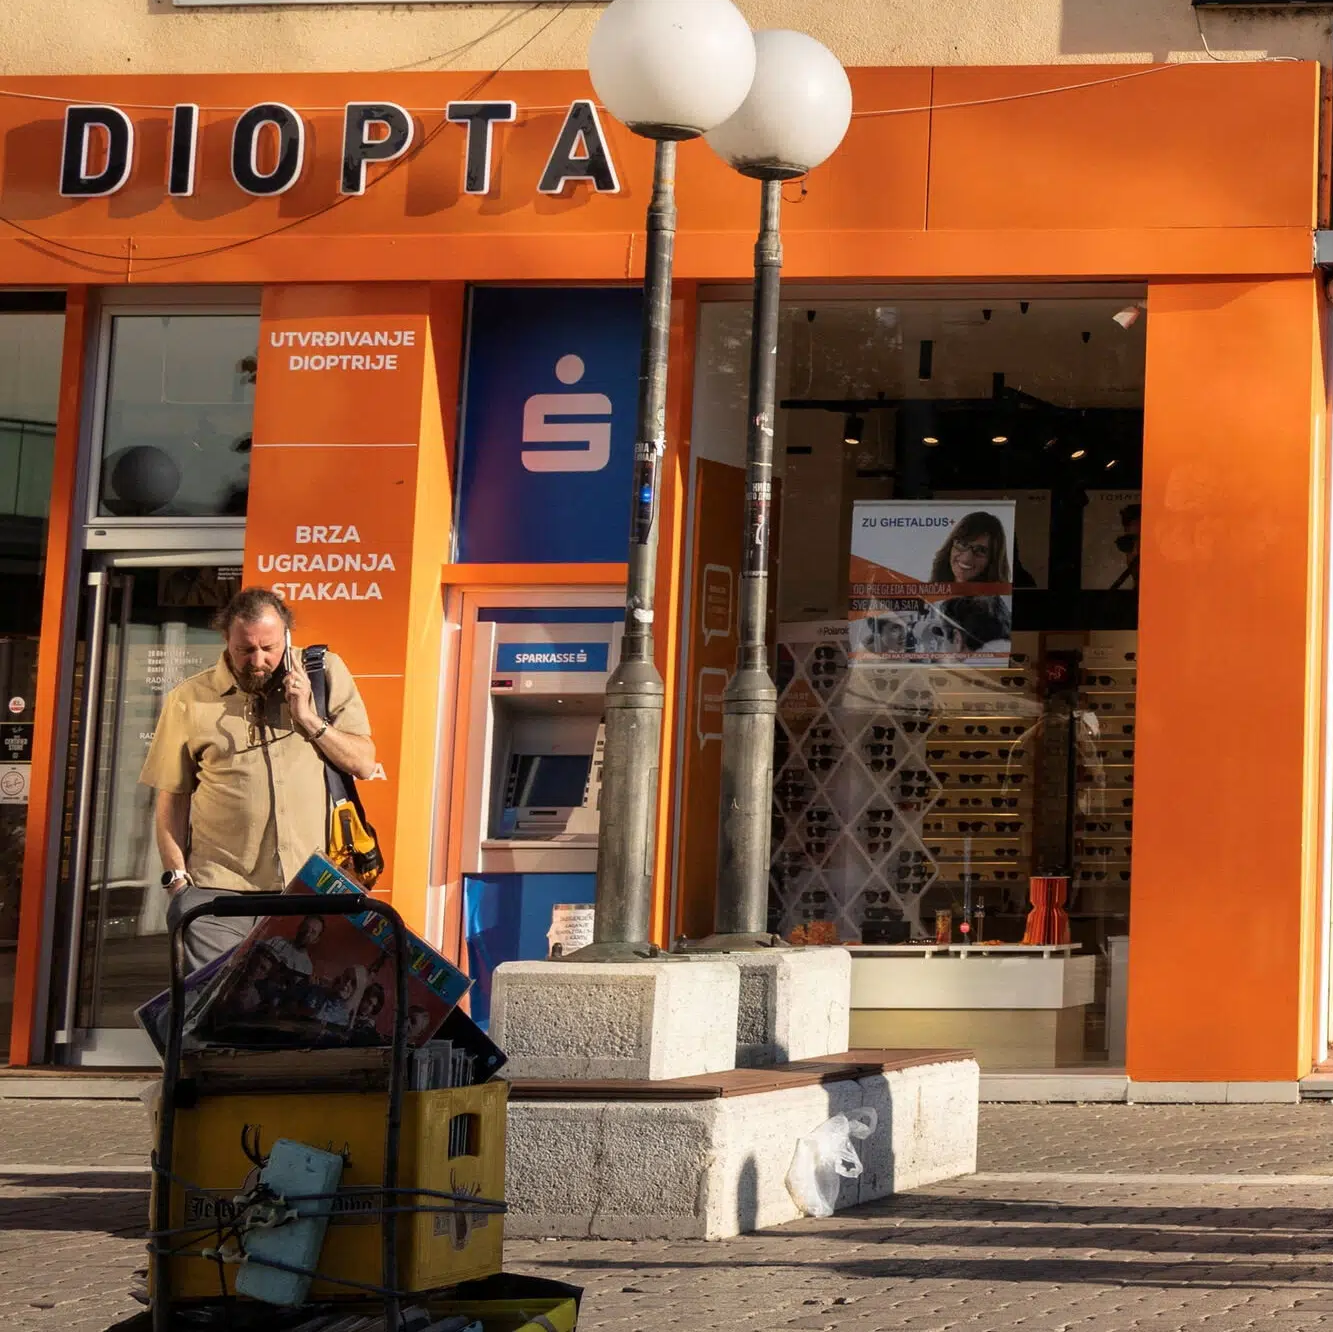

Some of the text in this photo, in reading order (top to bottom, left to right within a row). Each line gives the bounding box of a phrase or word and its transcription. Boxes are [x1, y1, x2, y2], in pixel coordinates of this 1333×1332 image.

[59, 100, 620, 197] DIOPTA
[271, 329, 415, 349] UTVRĐIVANJE
[288, 354, 398, 371] DIOPTRIJE
[862, 518, 877, 527] ZU
[295, 525, 361, 544] BRZA
[257, 553, 396, 573] UGRADNJA
[271, 581, 383, 601] STAKALA
[516, 653, 576, 664] SPARKASSE
